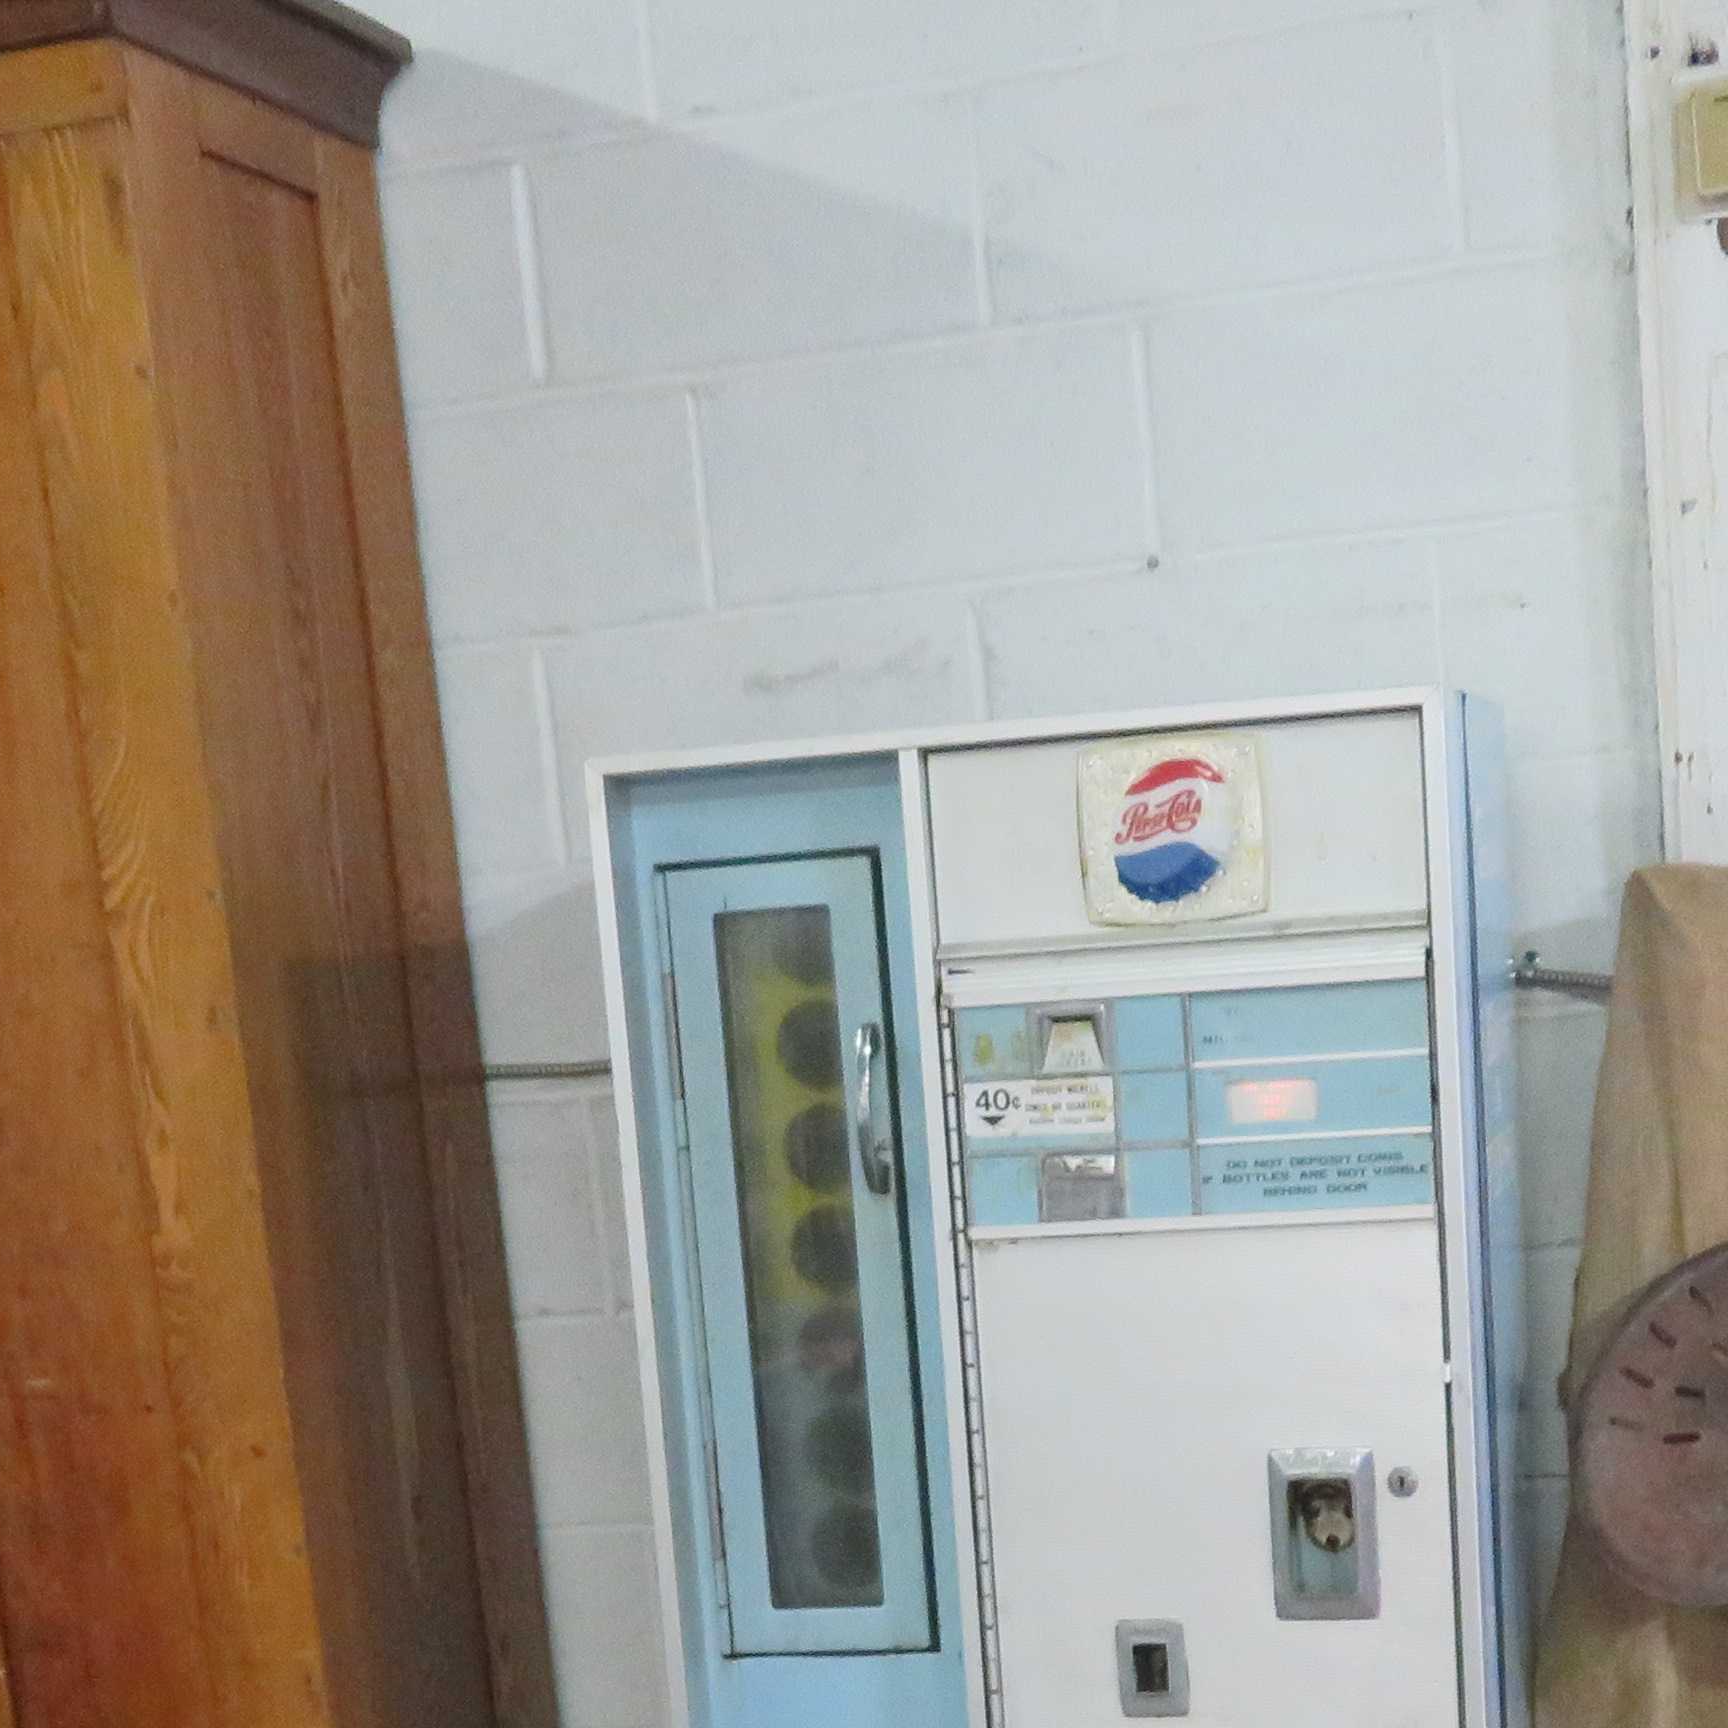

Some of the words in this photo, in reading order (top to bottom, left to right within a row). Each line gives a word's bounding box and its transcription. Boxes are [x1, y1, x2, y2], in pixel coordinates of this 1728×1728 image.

[1254, 1158, 1282, 1168] NOT
[1290, 1155, 1351, 1167] DEPOSIT
[1222, 1171, 1289, 1184] BOTTLES
[1299, 1169, 1327, 1180] ARE
[1337, 1168, 1365, 1178] NOT
